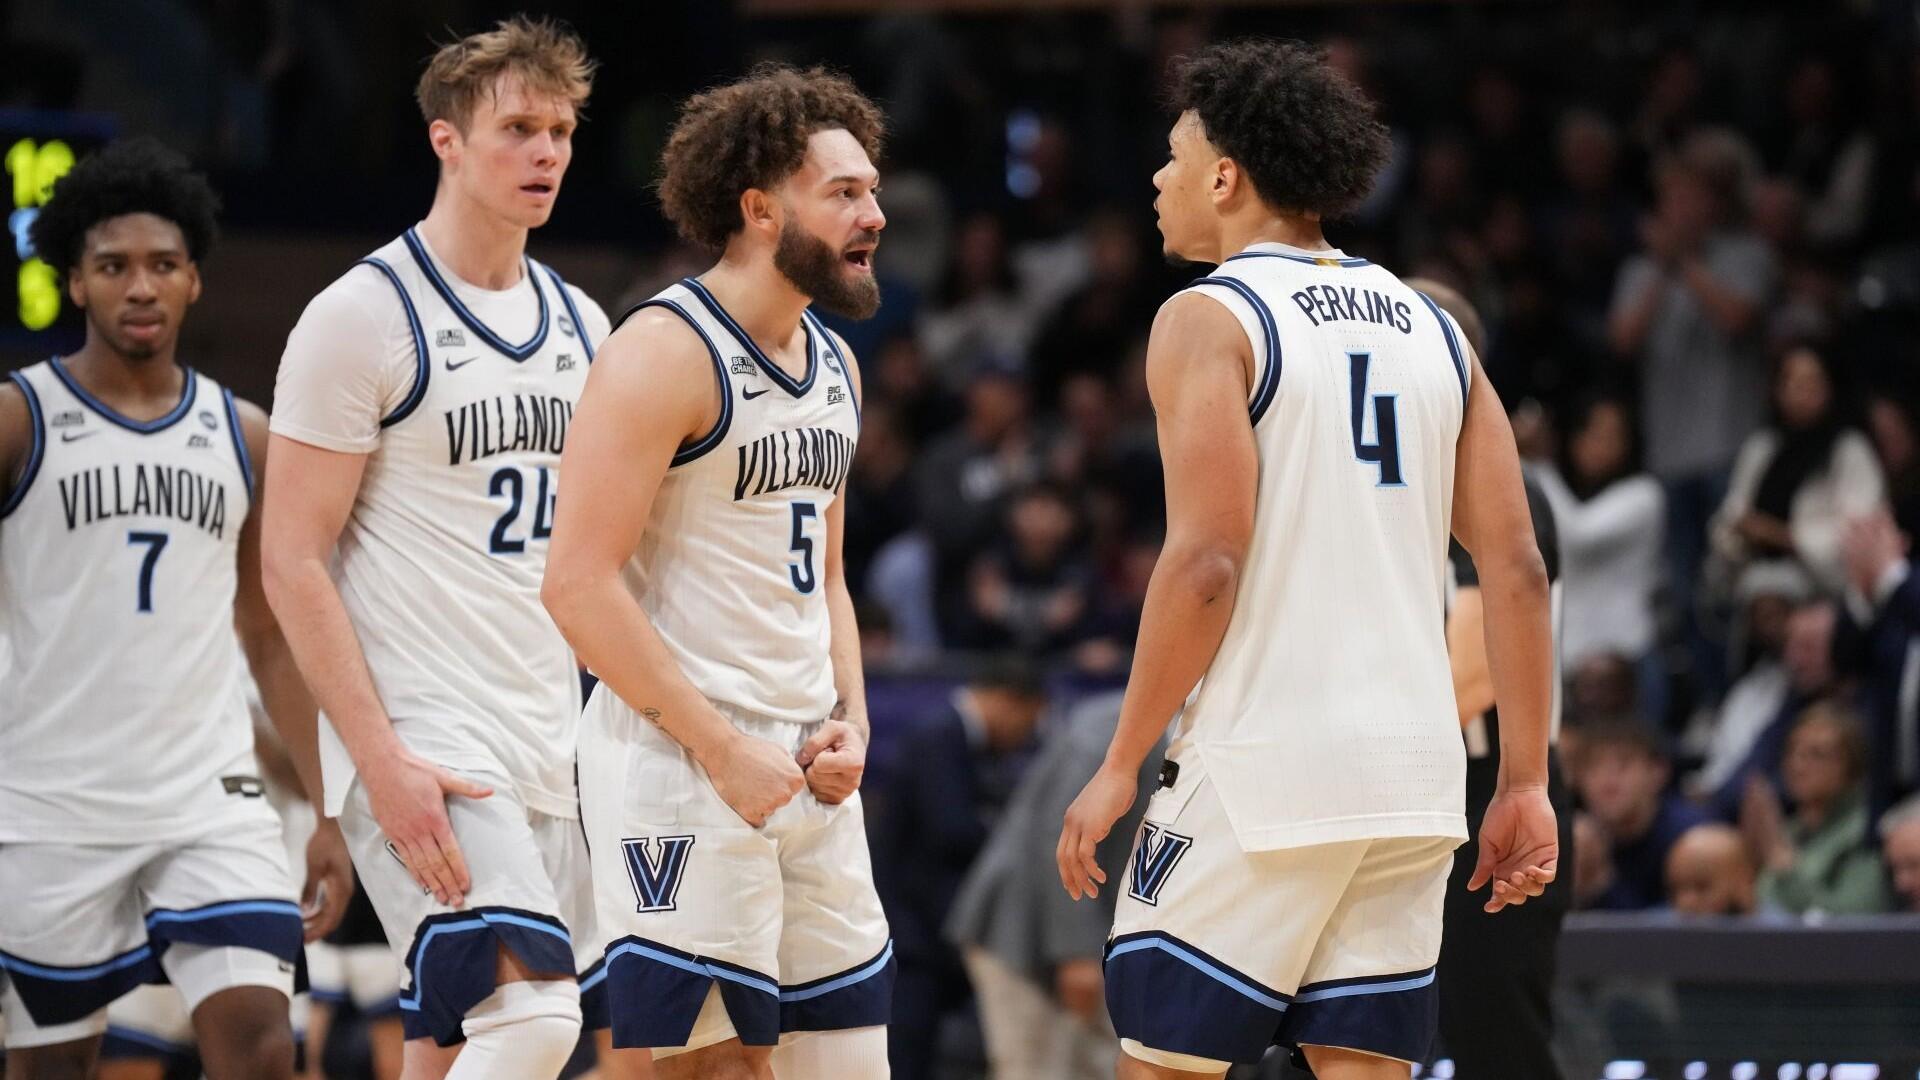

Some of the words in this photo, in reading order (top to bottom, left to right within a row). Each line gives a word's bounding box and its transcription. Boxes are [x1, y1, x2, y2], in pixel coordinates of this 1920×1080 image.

[1291, 284, 1412, 335] PERKINS
[828, 386, 841, 394] BIG
[828, 394, 846, 402] EAST
[1345, 352, 1408, 487] 4
[445, 394, 572, 466] VILLANO
[58, 464, 226, 541] VILLANOVA
[127, 529, 169, 613] 7
[788, 501, 817, 594] 5
[621, 835, 695, 913] V
[1128, 821, 1193, 907] V
